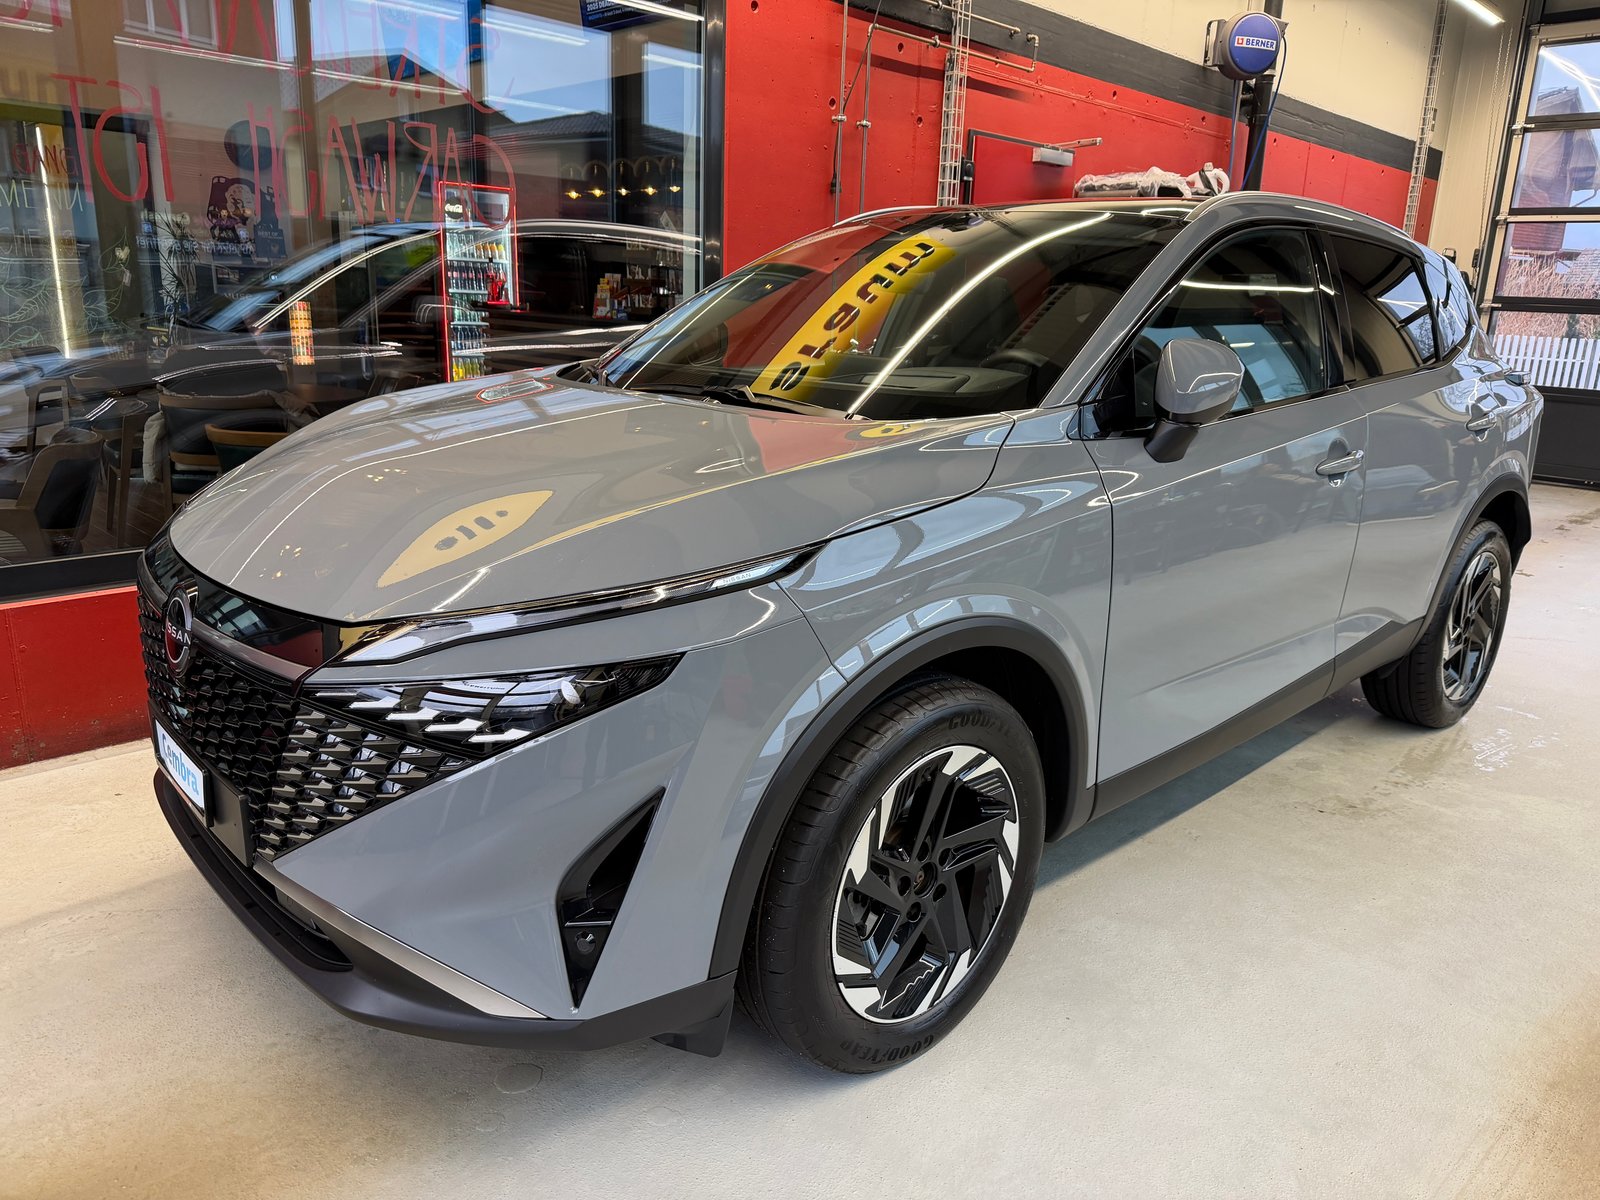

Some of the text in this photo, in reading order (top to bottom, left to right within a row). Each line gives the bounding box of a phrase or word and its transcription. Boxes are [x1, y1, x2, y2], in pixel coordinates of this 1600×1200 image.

[1245, 38, 1275, 49] BERNER
[722, 572, 752, 584] NISSAN
[166, 622, 191, 645] SSAN
